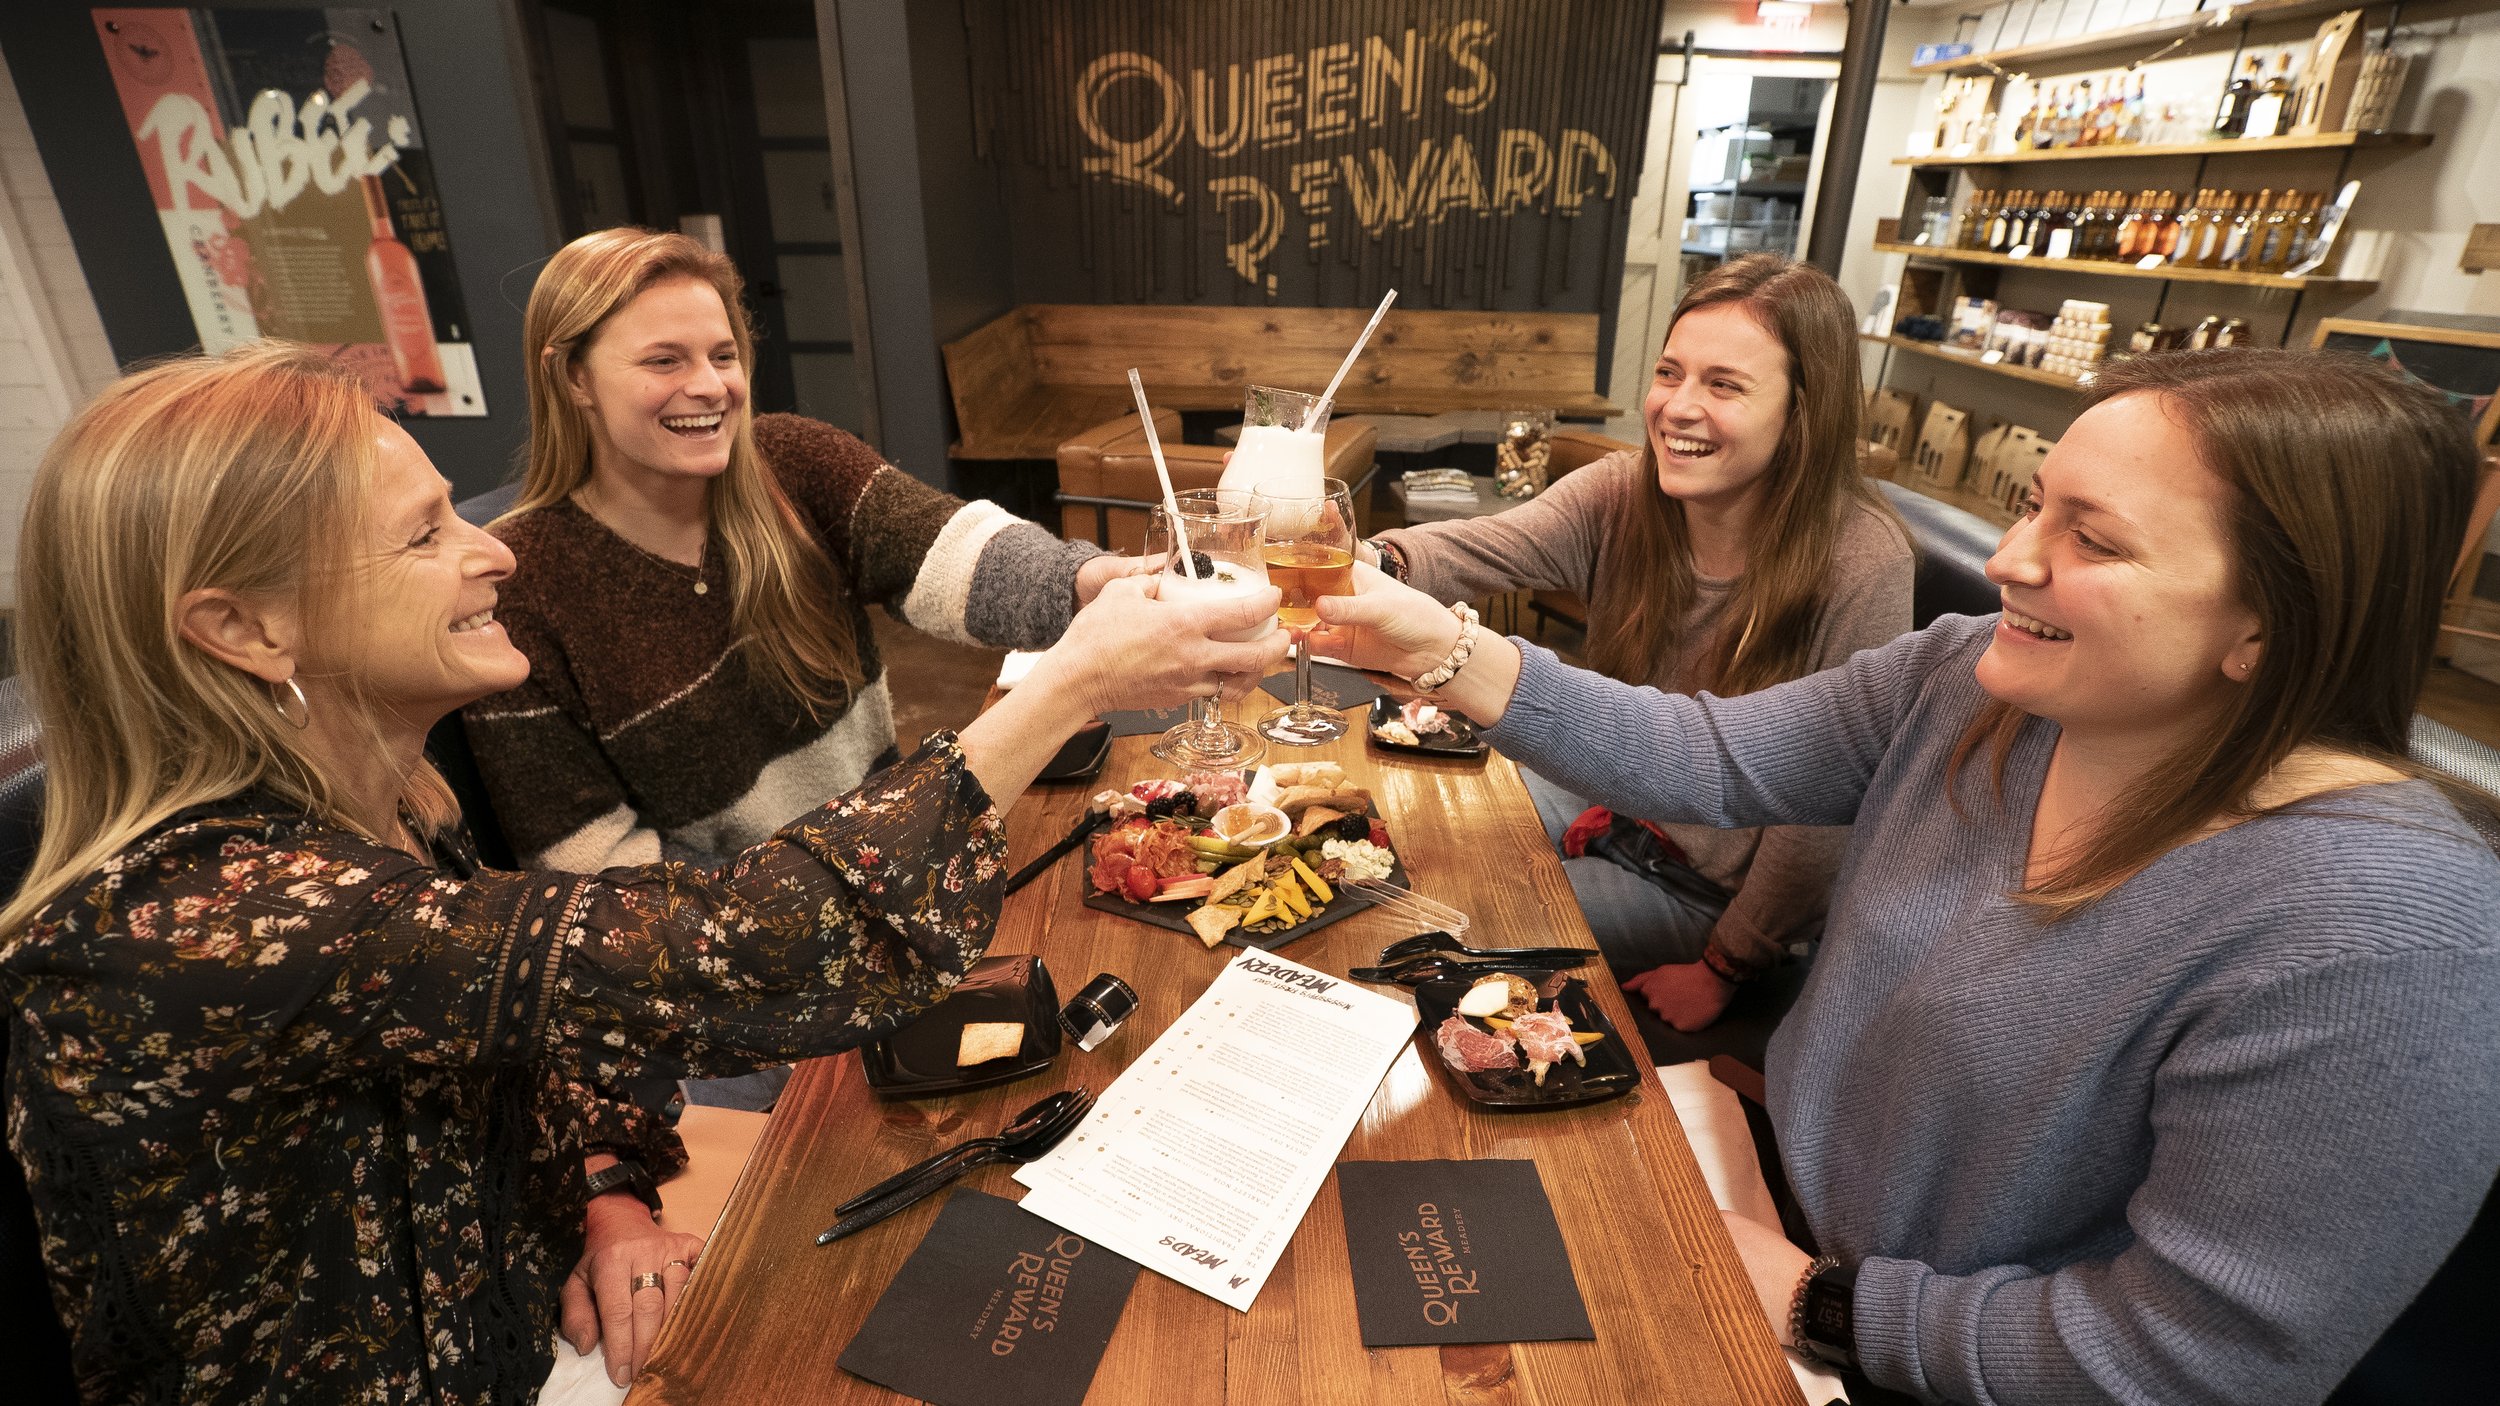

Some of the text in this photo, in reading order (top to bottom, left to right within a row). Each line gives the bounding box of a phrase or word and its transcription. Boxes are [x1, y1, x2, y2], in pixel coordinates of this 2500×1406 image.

[1076, 19, 1498, 205] QUEEN'S
[1208, 128, 1617, 296] REWARD
[1236, 957, 1338, 994] MEADERY
[1159, 1236, 1228, 1269] MEADS
[1417, 1202, 1480, 1294] REWARD
[1453, 1208, 1470, 1255] MEADERY
[969, 1288, 1004, 1340] MEADERY
[991, 1251, 1044, 1357] REWARD
[1032, 1233, 1085, 1333] QUEEN'S
[1398, 1231, 1460, 1326] QUEEN'S
[1818, 1307, 1844, 1328] 5:57
